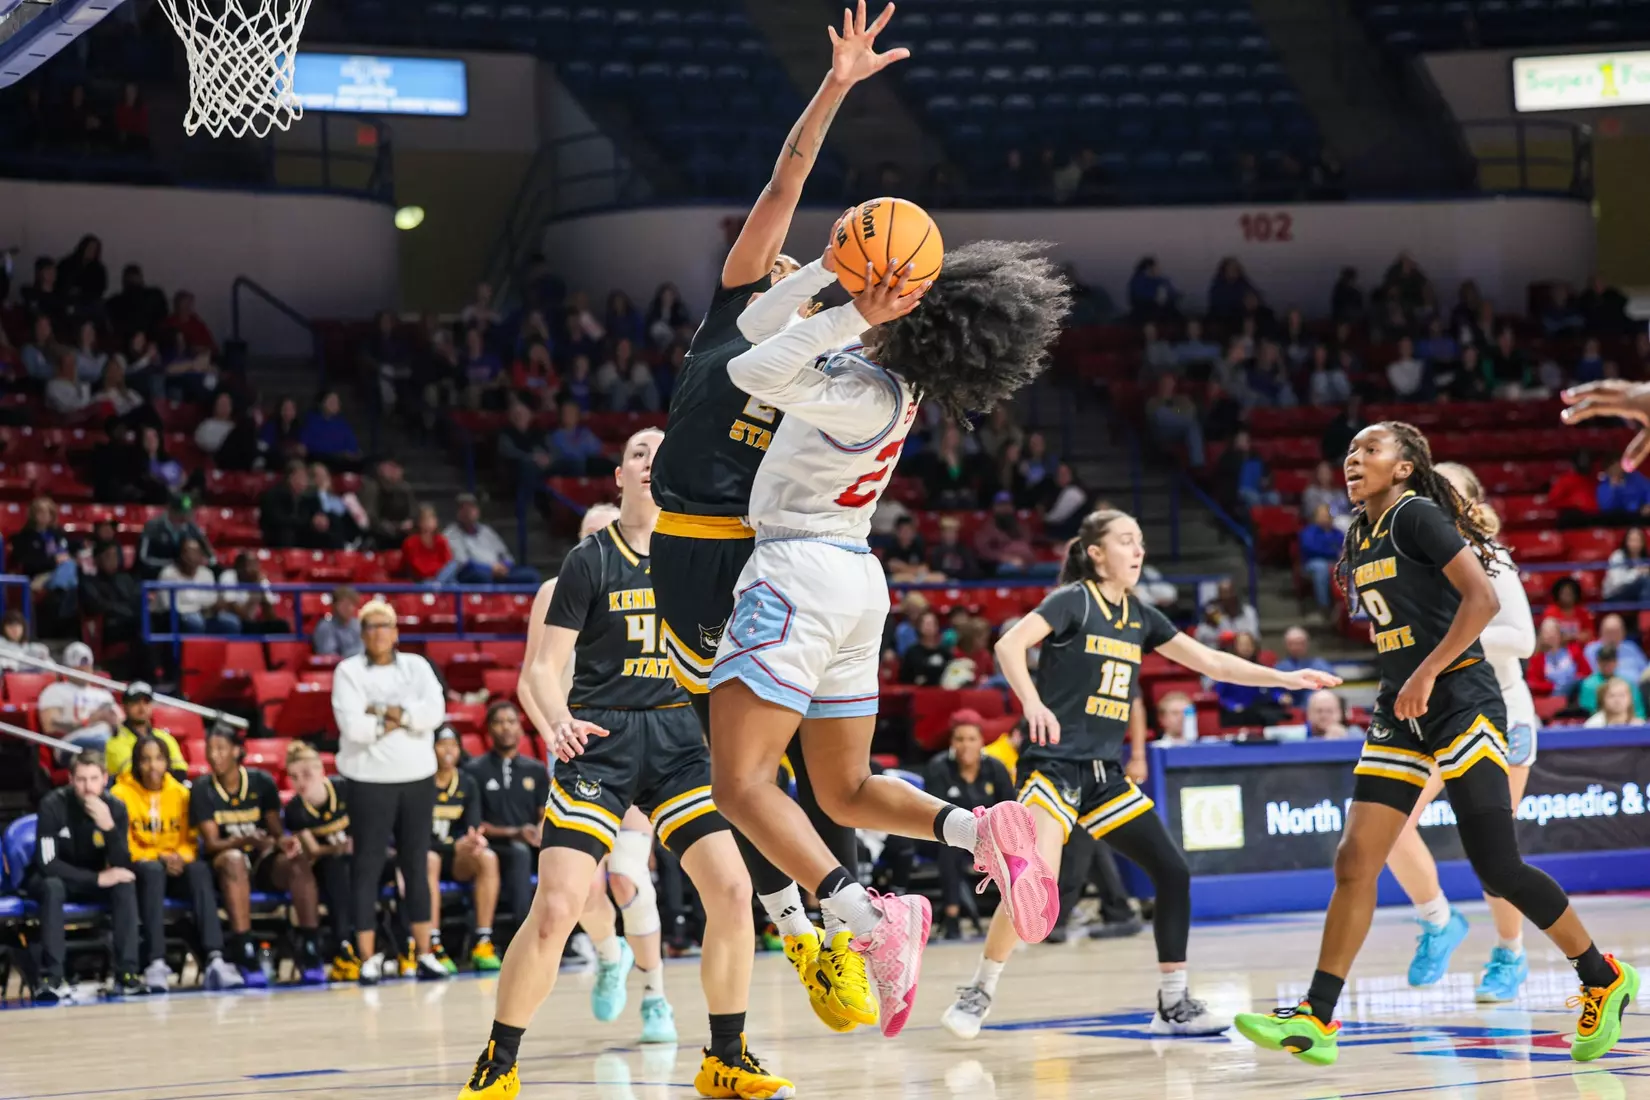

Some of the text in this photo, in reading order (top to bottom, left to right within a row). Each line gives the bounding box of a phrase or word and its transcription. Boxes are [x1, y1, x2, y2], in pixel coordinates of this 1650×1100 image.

[1596, 59, 1619, 97] 1
[1238, 212, 1294, 242] 102
[729, 418, 775, 452] STA
[608, 587, 656, 612] KENN
[1360, 588, 1393, 626] 0
[624, 613, 667, 654] 4
[1375, 624, 1416, 654] TATE
[620, 657, 675, 679] STAT
[1096, 660, 1132, 700] 12
[1084, 695, 1130, 722] STATE
[1266, 798, 1342, 836] North
[1516, 783, 1619, 827] opaedic
[1621, 782, 1646, 815] &
